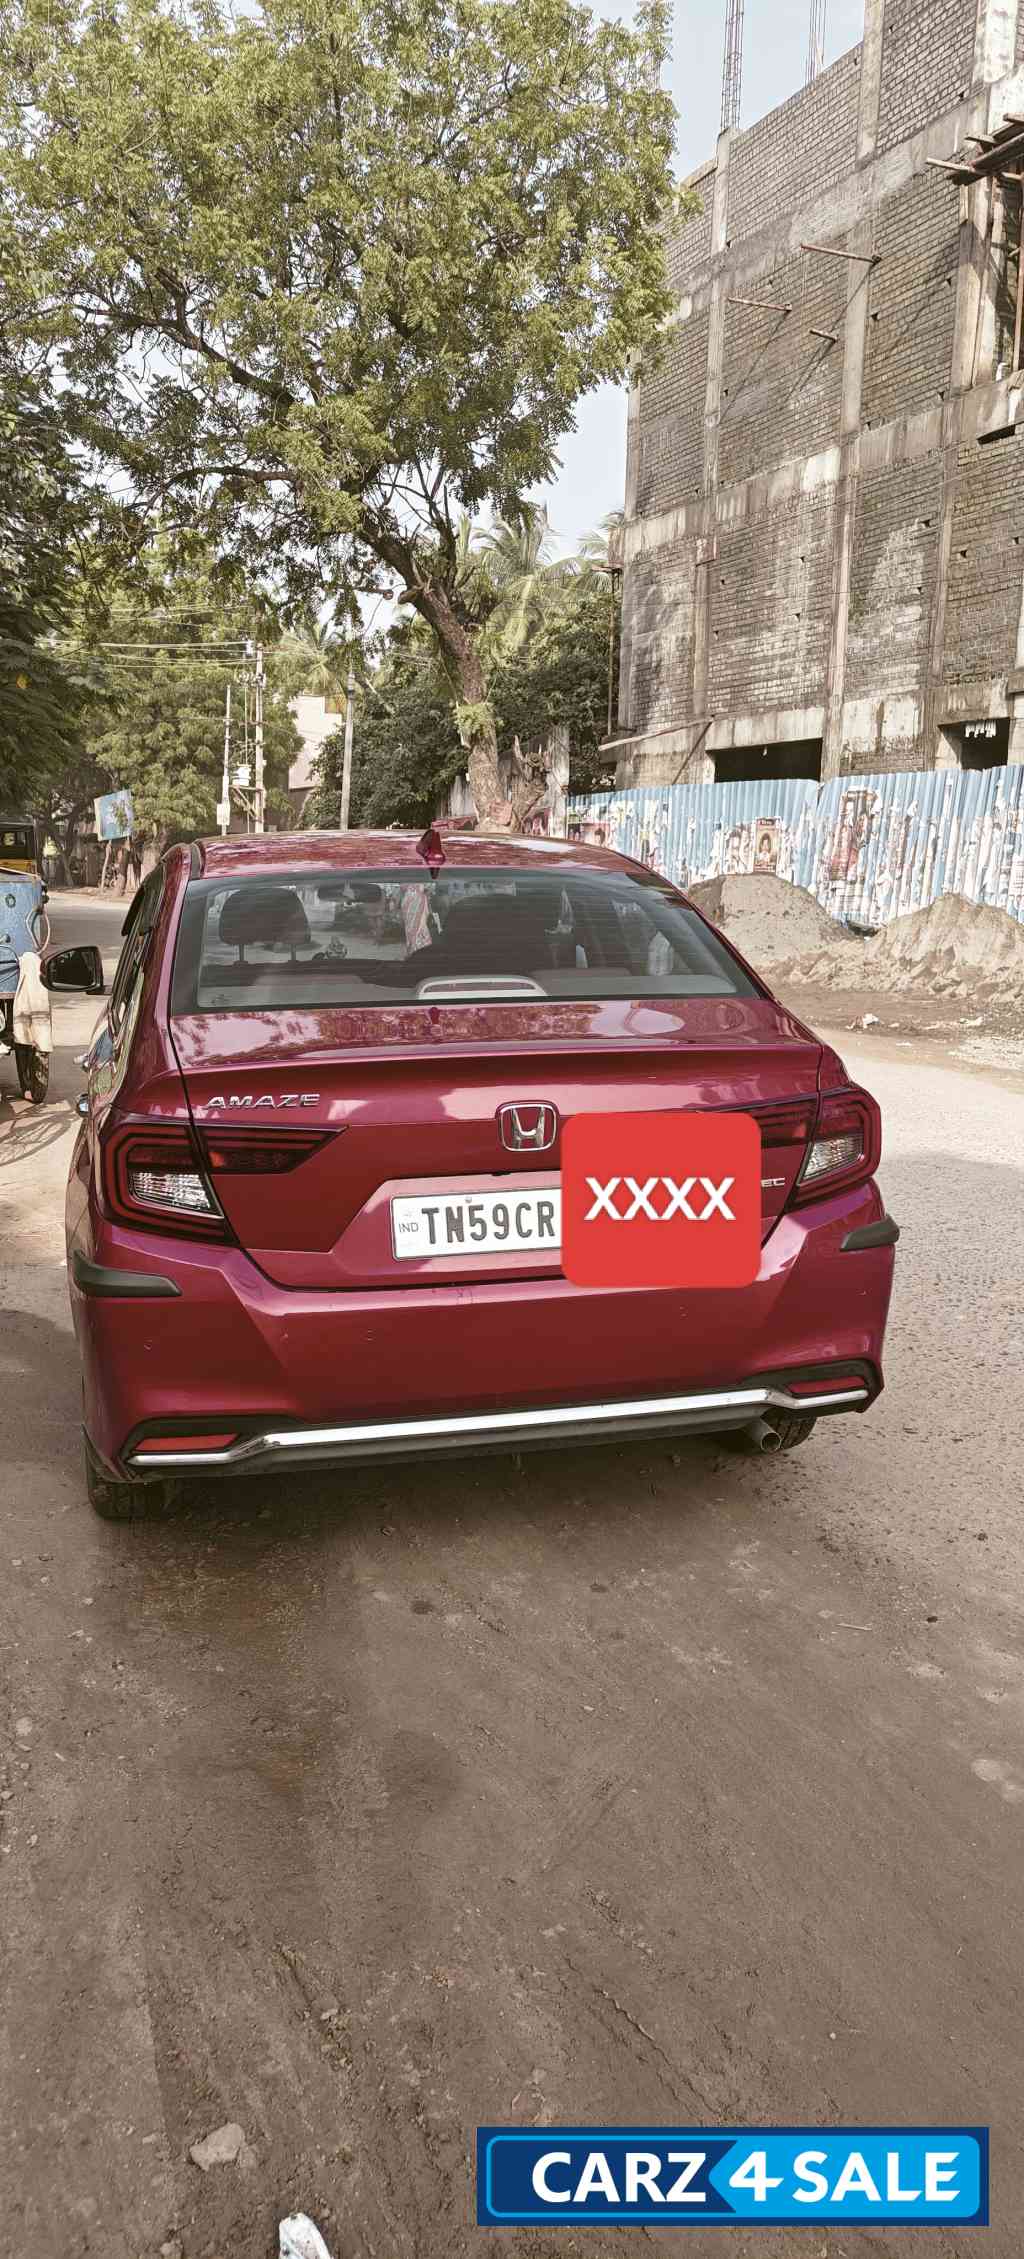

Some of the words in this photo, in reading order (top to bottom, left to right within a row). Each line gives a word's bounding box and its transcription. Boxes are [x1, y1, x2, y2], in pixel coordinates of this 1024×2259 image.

[208, 1094, 320, 1109] AMAZE
[761, 1177, 785, 1187] EC
[399, 1222, 419, 1232] IND
[422, 1201, 555, 1244] TN59CR
